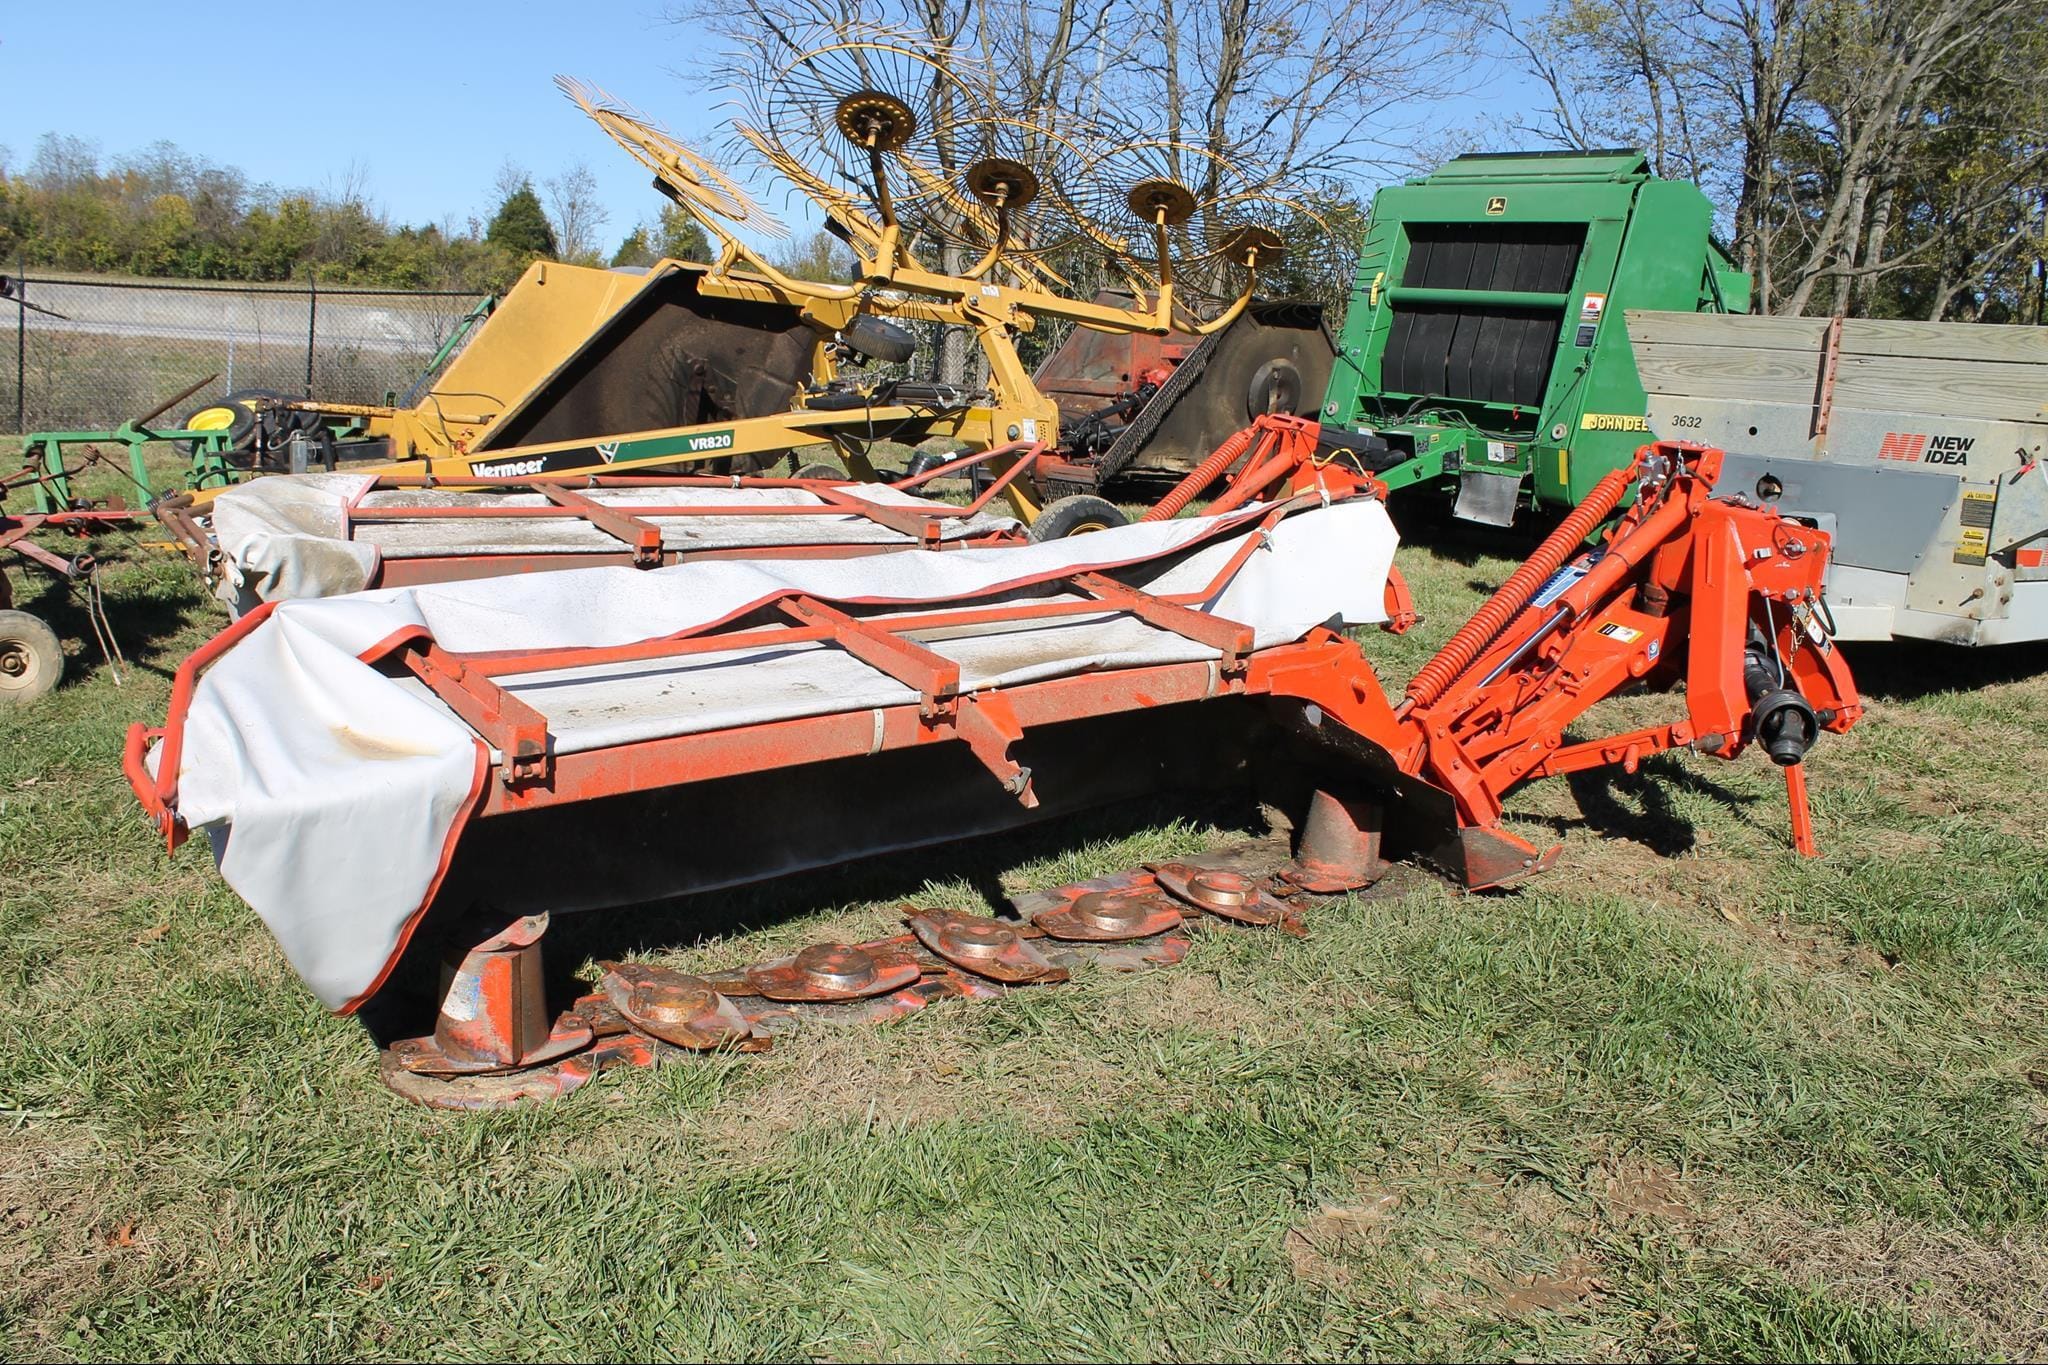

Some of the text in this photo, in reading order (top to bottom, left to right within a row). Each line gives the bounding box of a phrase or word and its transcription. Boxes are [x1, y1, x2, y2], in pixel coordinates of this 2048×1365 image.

[1590, 415, 1652, 433] JOHN DEE
[1671, 415, 1702, 429] 3632
[689, 435, 731, 451] VR820
[1878, 432, 1927, 463] NI
[1930, 436, 1975, 451] NEW
[1924, 450, 1968, 466] IDEA
[472, 460, 544, 477] Vermeer
